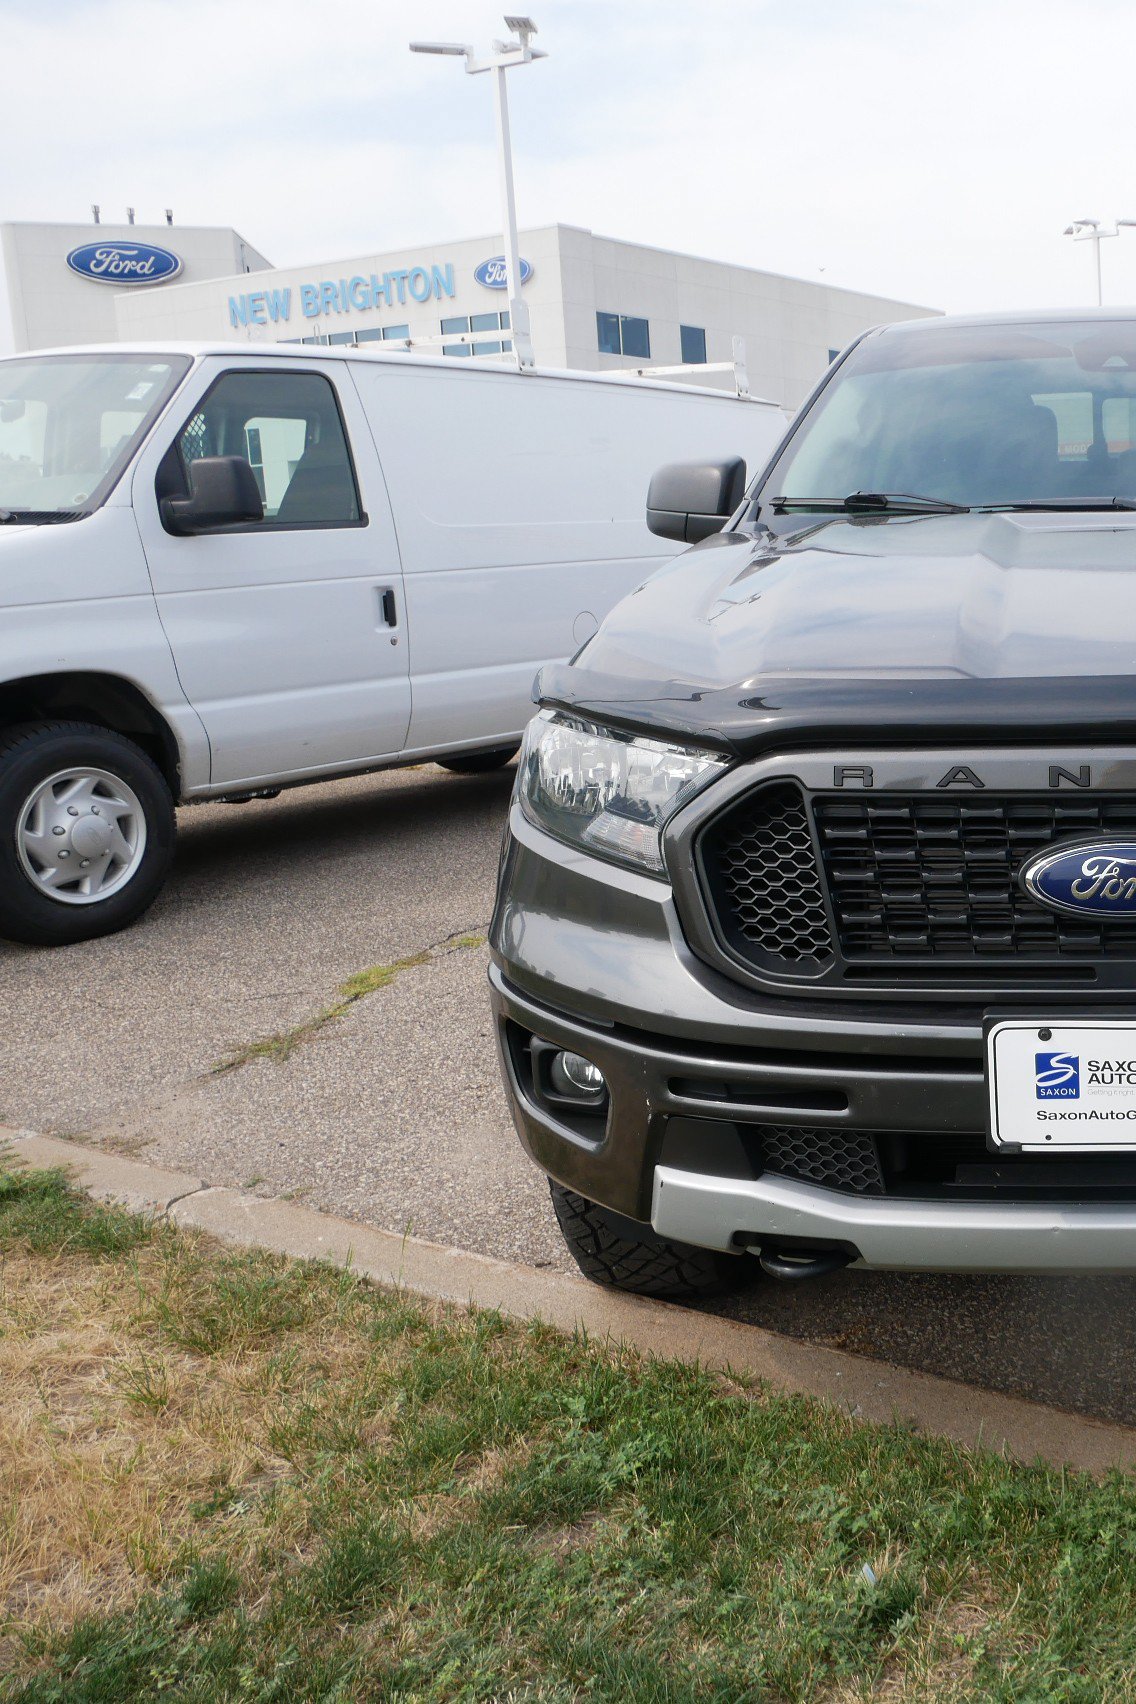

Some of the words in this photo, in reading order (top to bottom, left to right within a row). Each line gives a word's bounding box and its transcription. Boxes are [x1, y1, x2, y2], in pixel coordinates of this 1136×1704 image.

[90, 247, 155, 275] Ford
[228, 287, 292, 328] NEW
[300, 263, 456, 318] BRIGHTON
[1040, 1088, 1076, 1096] SAXON
[1087, 1088, 1112, 1096] Getting
